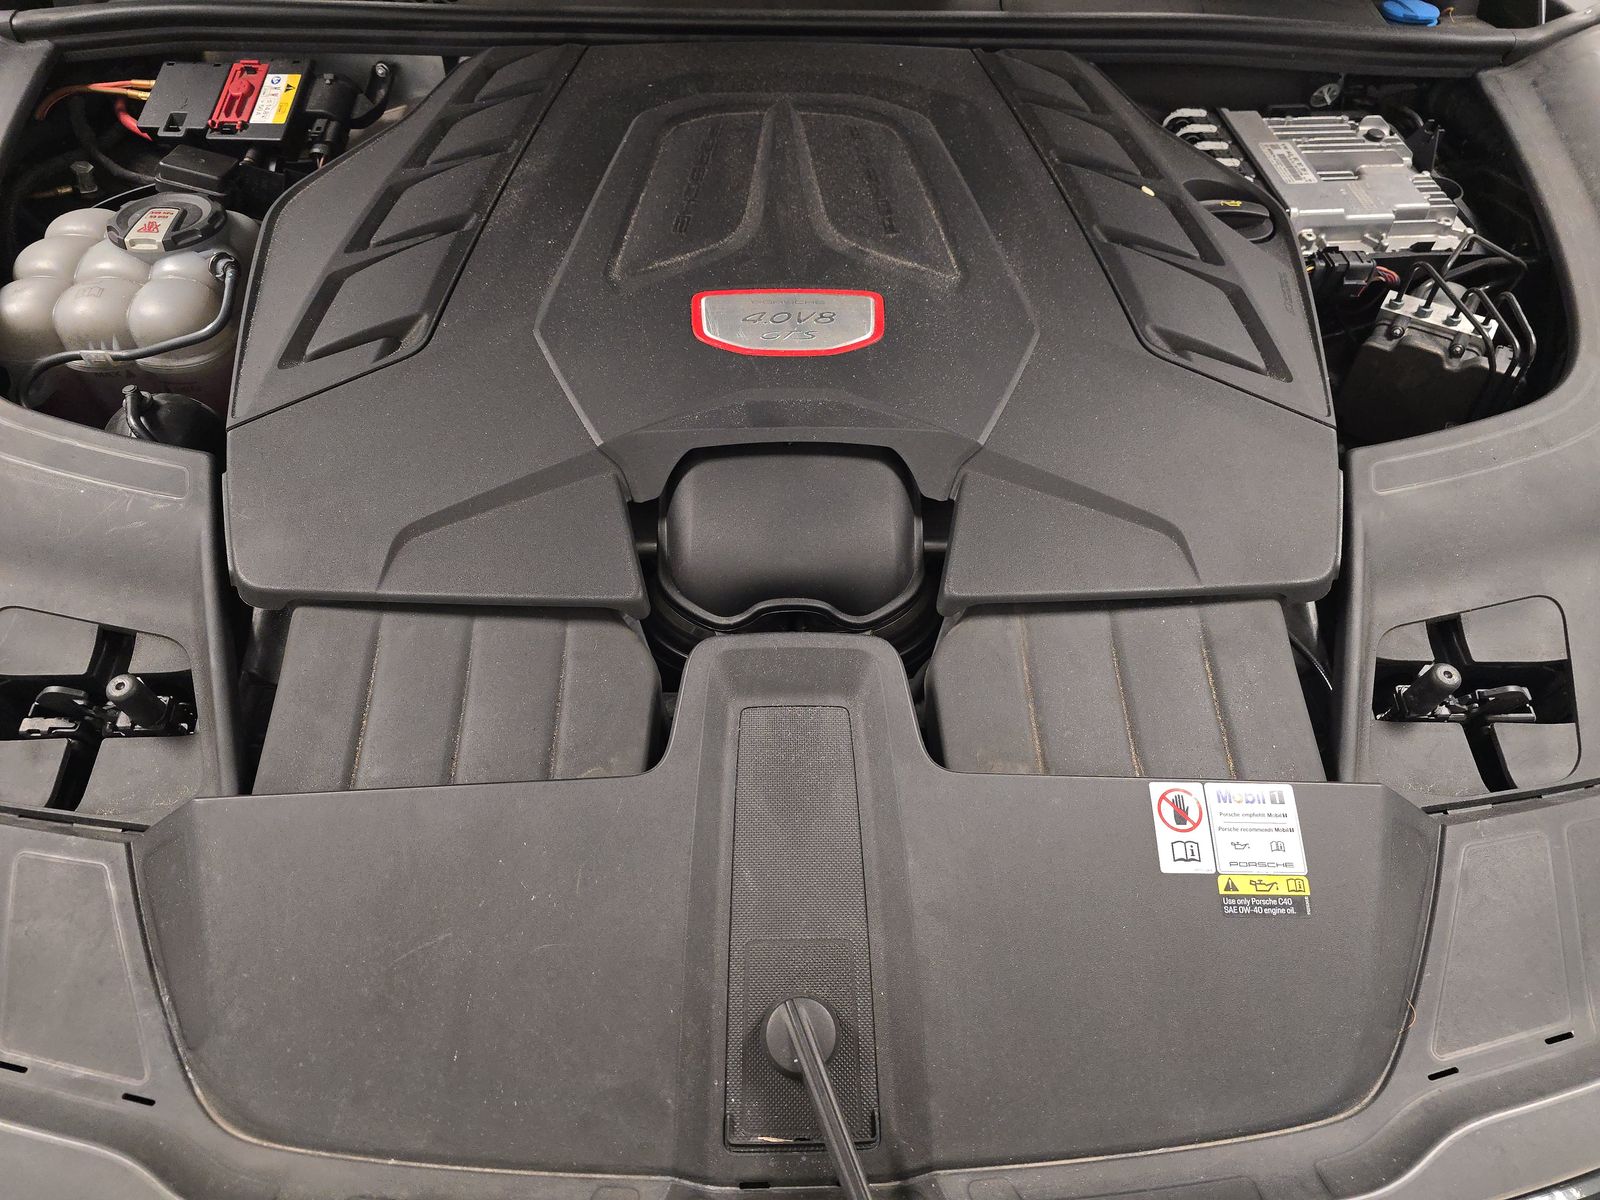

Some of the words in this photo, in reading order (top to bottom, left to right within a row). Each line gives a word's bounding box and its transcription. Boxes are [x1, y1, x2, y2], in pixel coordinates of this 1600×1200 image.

[1216, 789, 1266, 804] Mobil
[1222, 897, 1236, 905] Use
[1237, 897, 1251, 906] only
[1251, 897, 1277, 905] Porsche
[1223, 906, 1238, 914] SAE
[1238, 906, 1263, 914] 0W-40
[1263, 907, 1286, 915] engine
